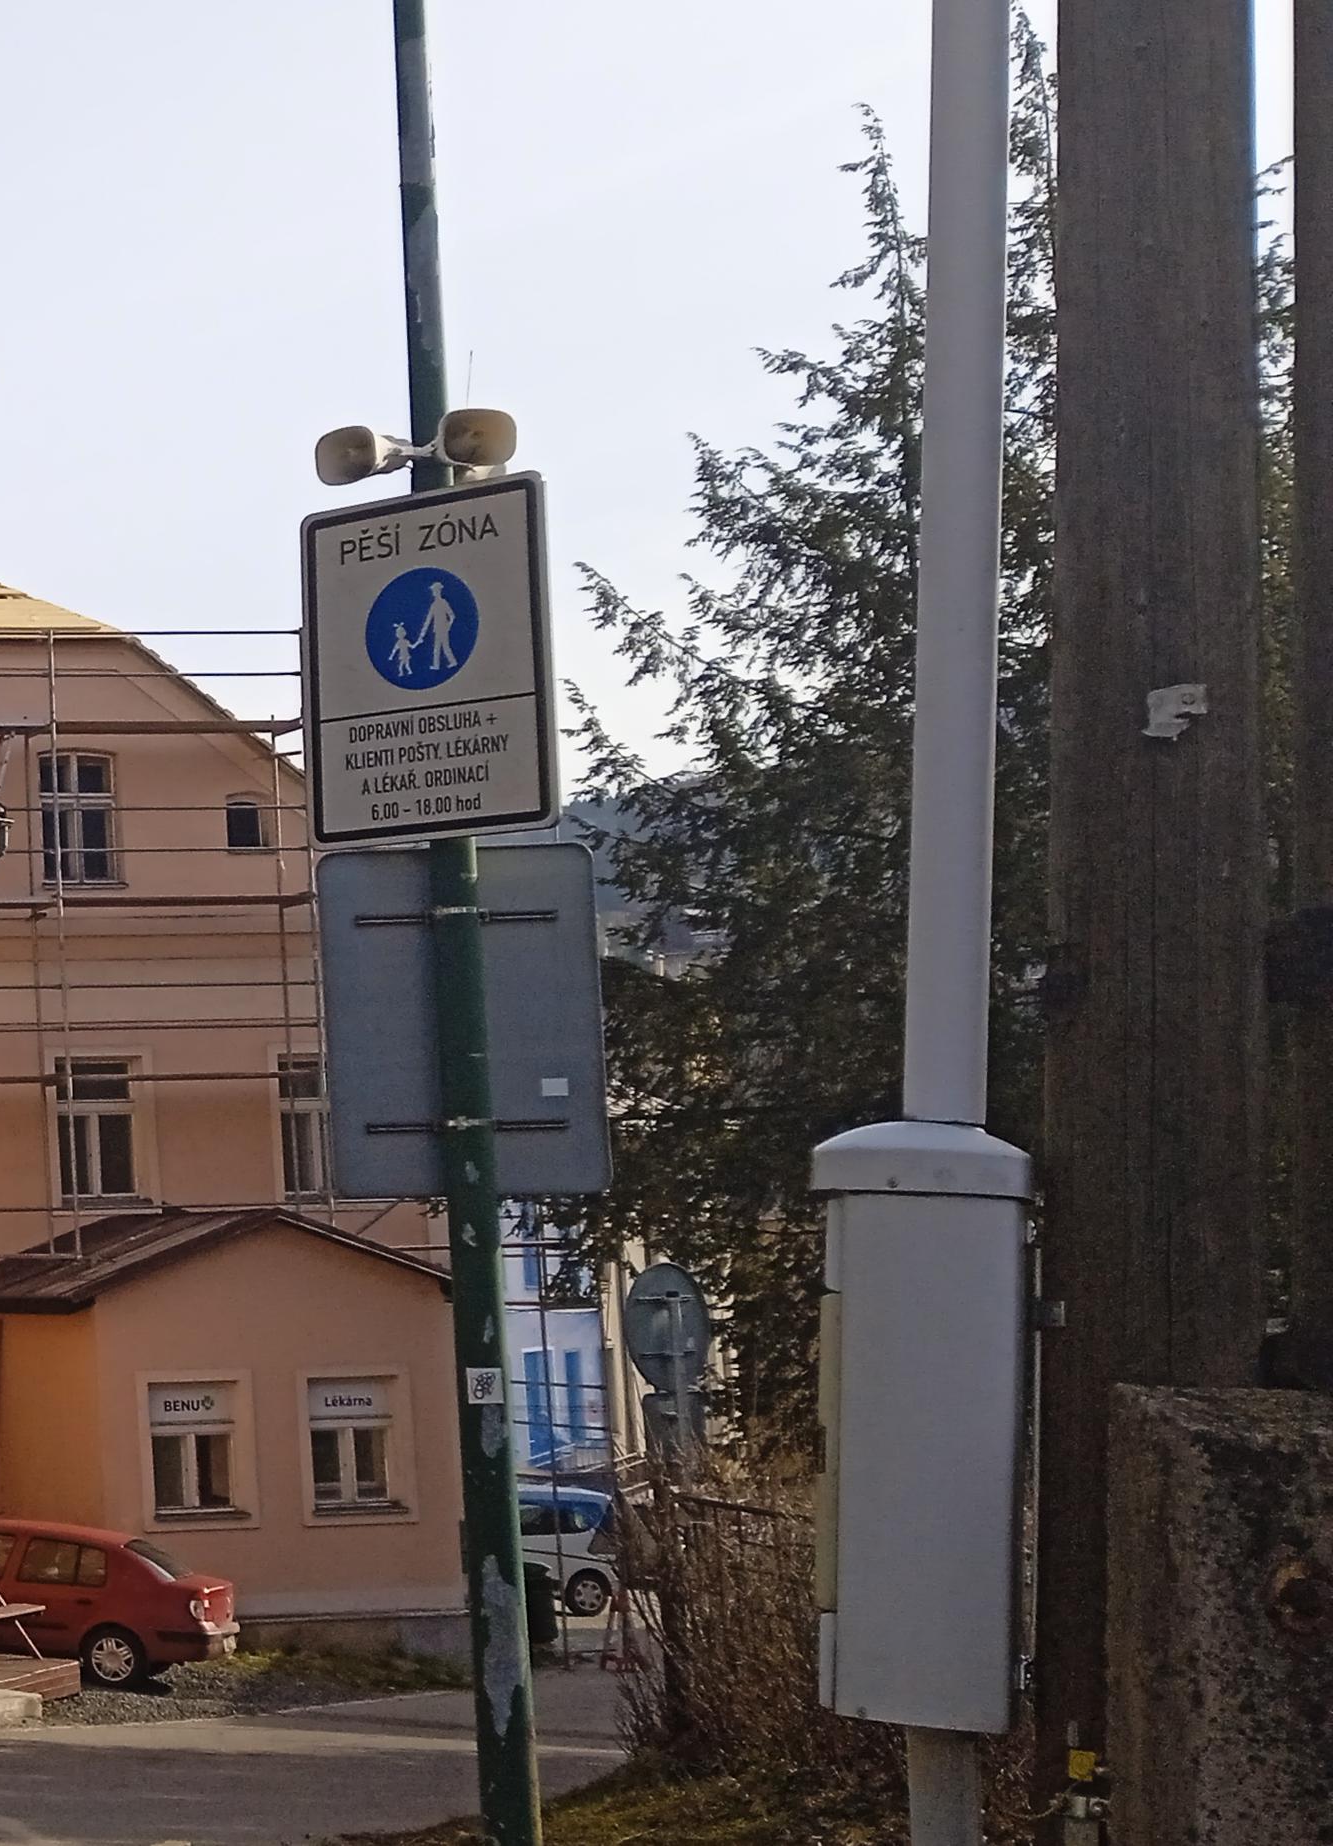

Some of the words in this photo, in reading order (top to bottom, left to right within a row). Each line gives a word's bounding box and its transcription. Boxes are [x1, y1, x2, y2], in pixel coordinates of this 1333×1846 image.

[340, 523, 400, 565] PĚŠÍ
[418, 513, 499, 551] ZÓNA
[349, 715, 414, 743] DOPRAVNÍ
[418, 710, 481, 734] OBSLUHA
[486, 713, 497, 725] +
[345, 748, 394, 771] KLIENTI
[446, 734, 509, 759] LÉKÁRNY
[361, 779, 370, 795] A
[425, 760, 490, 788] ORDINACÍ
[371, 803, 399, 821] 6.00
[416, 795, 452, 816] 18.00
[456, 793, 481, 812] hod
[164, 1400, 200, 1411] BENU
[324, 1395, 372, 1407] Lékárna
